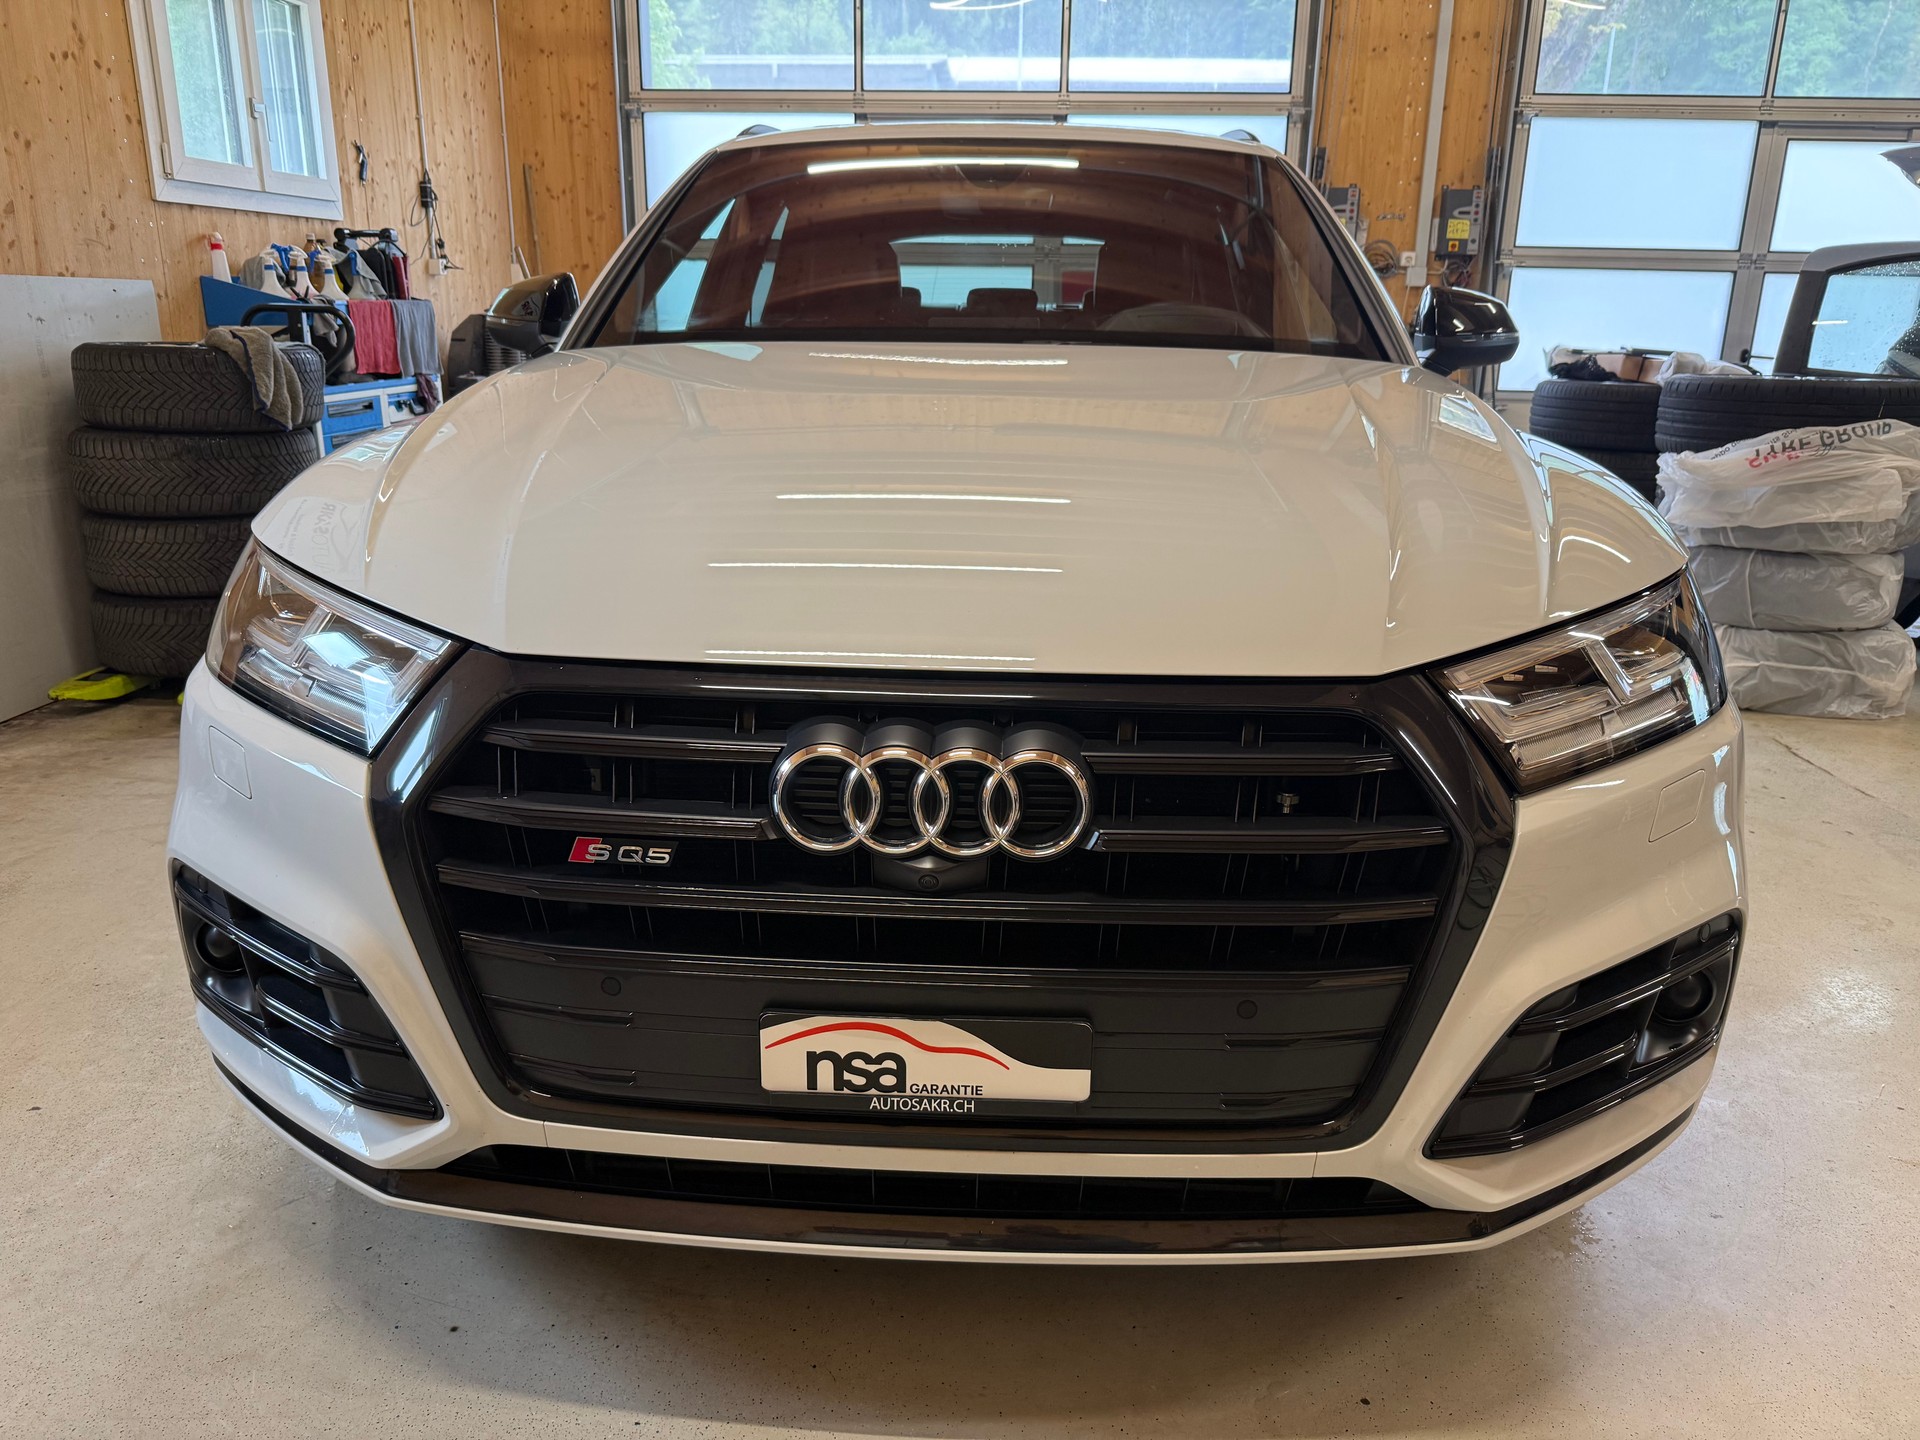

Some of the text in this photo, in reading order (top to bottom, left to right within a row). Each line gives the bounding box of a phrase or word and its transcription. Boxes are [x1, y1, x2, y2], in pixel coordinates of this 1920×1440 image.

[585, 844, 672, 864] SQ5
[806, 1050, 984, 1096] nsa GARANTIE
[869, 1096, 975, 1113] AUTOSAKR.CH
